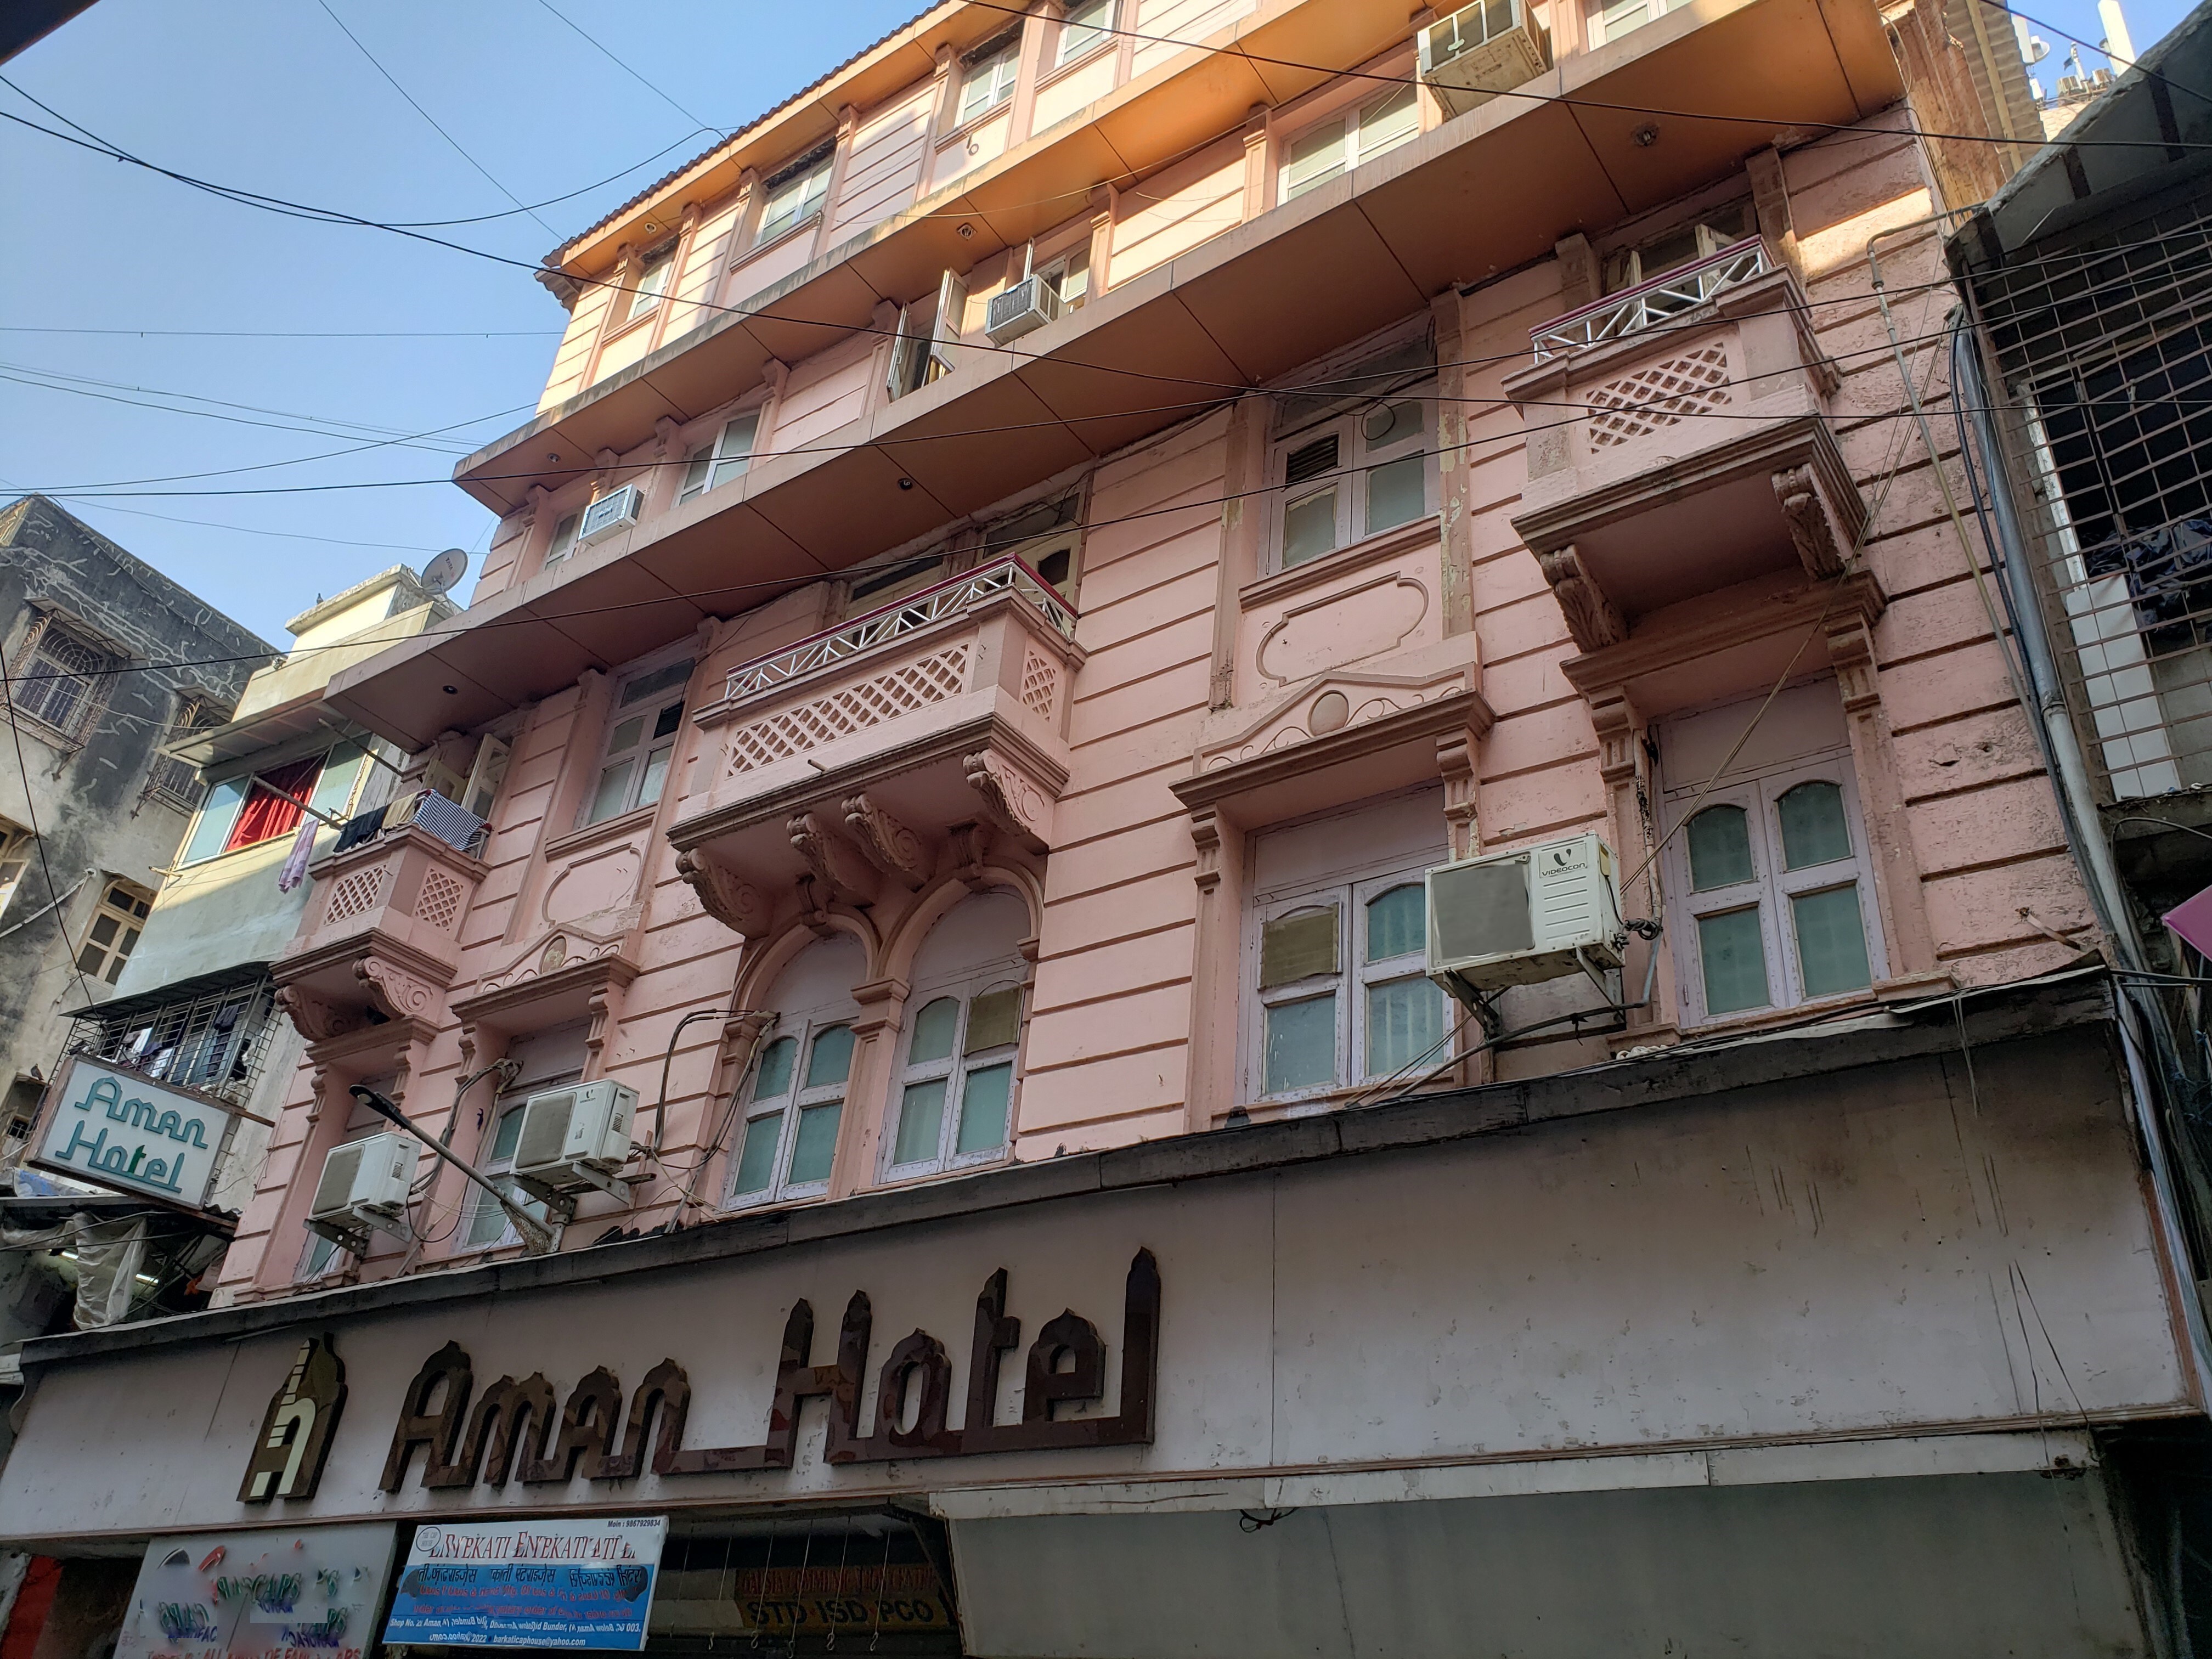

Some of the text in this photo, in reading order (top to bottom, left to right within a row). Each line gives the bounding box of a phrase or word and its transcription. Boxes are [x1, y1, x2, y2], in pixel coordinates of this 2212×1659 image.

[1542, 862, 1585, 877] VIDEOCON
[55, 1120, 185, 1193] Hotel
[766, 1245, 1161, 1476] Hotel
[390, 1618, 404, 1628] Shop
[405, 1618, 415, 1627] No.
[747, 1598, 934, 1624] STD ISD PCO
